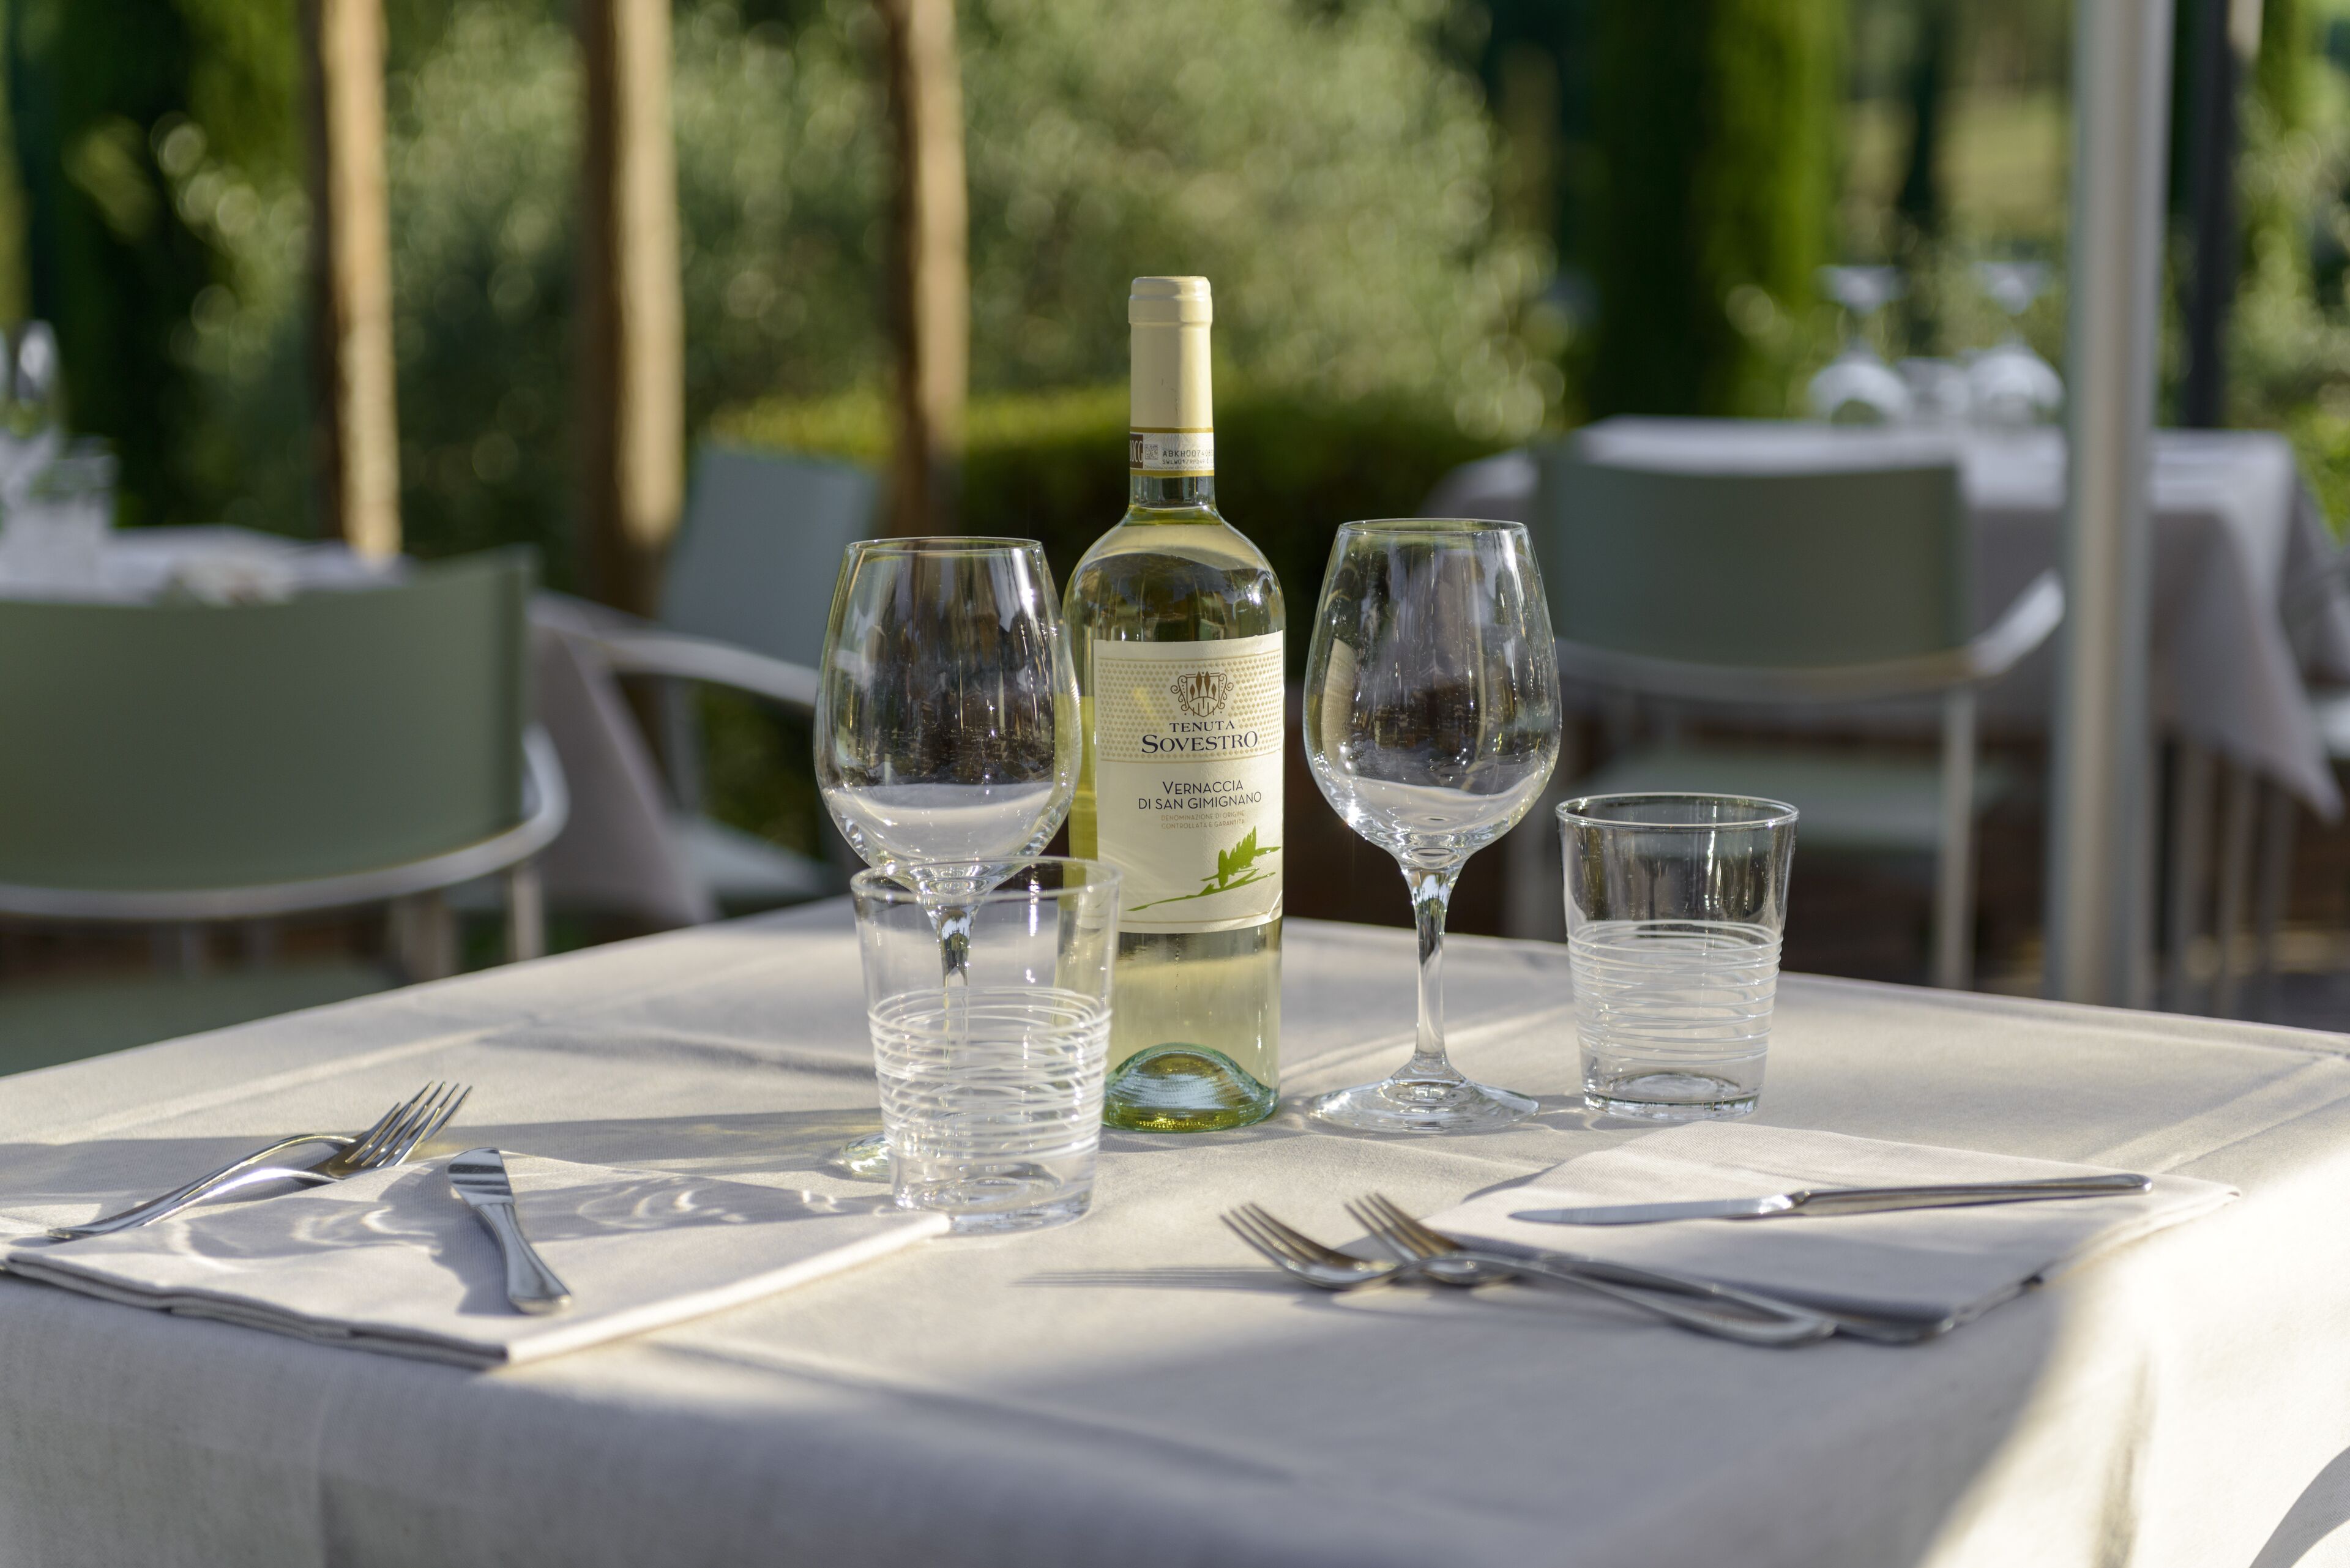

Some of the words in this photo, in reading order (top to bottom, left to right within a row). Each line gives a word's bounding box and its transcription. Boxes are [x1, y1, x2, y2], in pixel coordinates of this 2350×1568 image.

[1169, 720, 1235, 733] TENUTA
[1141, 731, 1258, 753] SOVESTRO
[1162, 780, 1244, 794] VERNACCIA
[1138, 798, 1151, 810] DI
[1155, 797, 1183, 810] SAN
[1187, 791, 1262, 810] GIMIGNANO
[1160, 813, 1214, 822] DENOMINAZIONE
[1222, 810, 1245, 819] ORIGINE
[1214, 818, 1245, 827] GARANTITA
